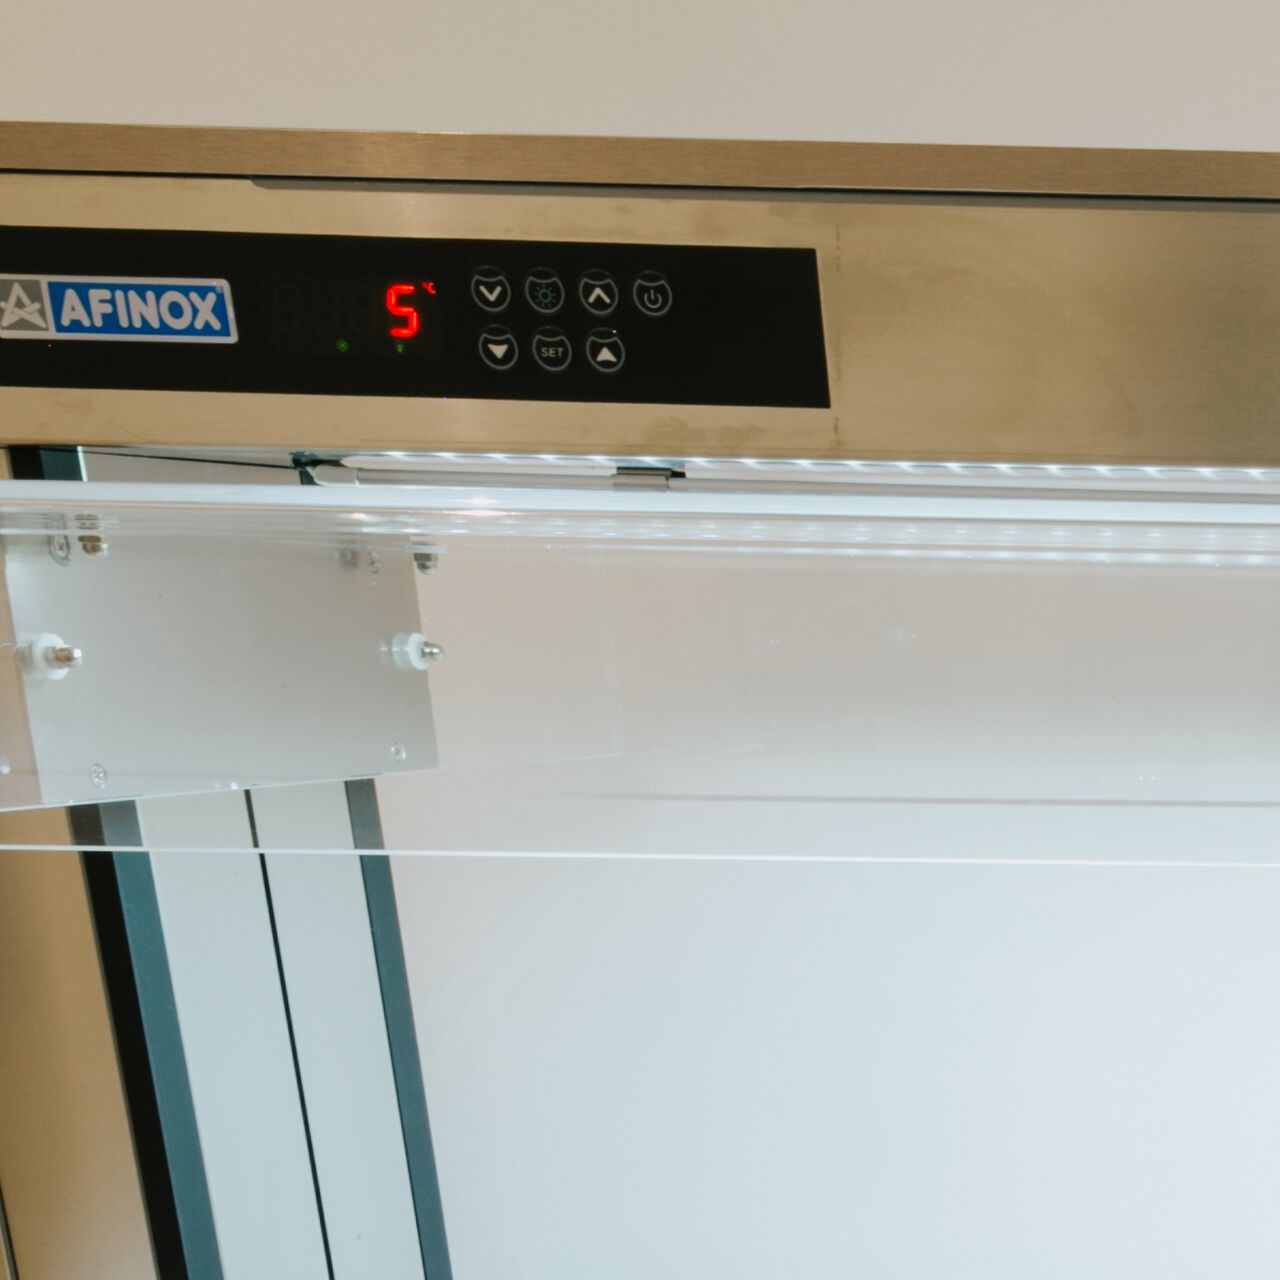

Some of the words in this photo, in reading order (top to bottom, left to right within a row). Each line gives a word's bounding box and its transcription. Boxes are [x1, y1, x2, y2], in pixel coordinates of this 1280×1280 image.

[60, 288, 222, 330] AFINOX
[385, 283, 419, 339] 5
[541, 347, 564, 358] SET
